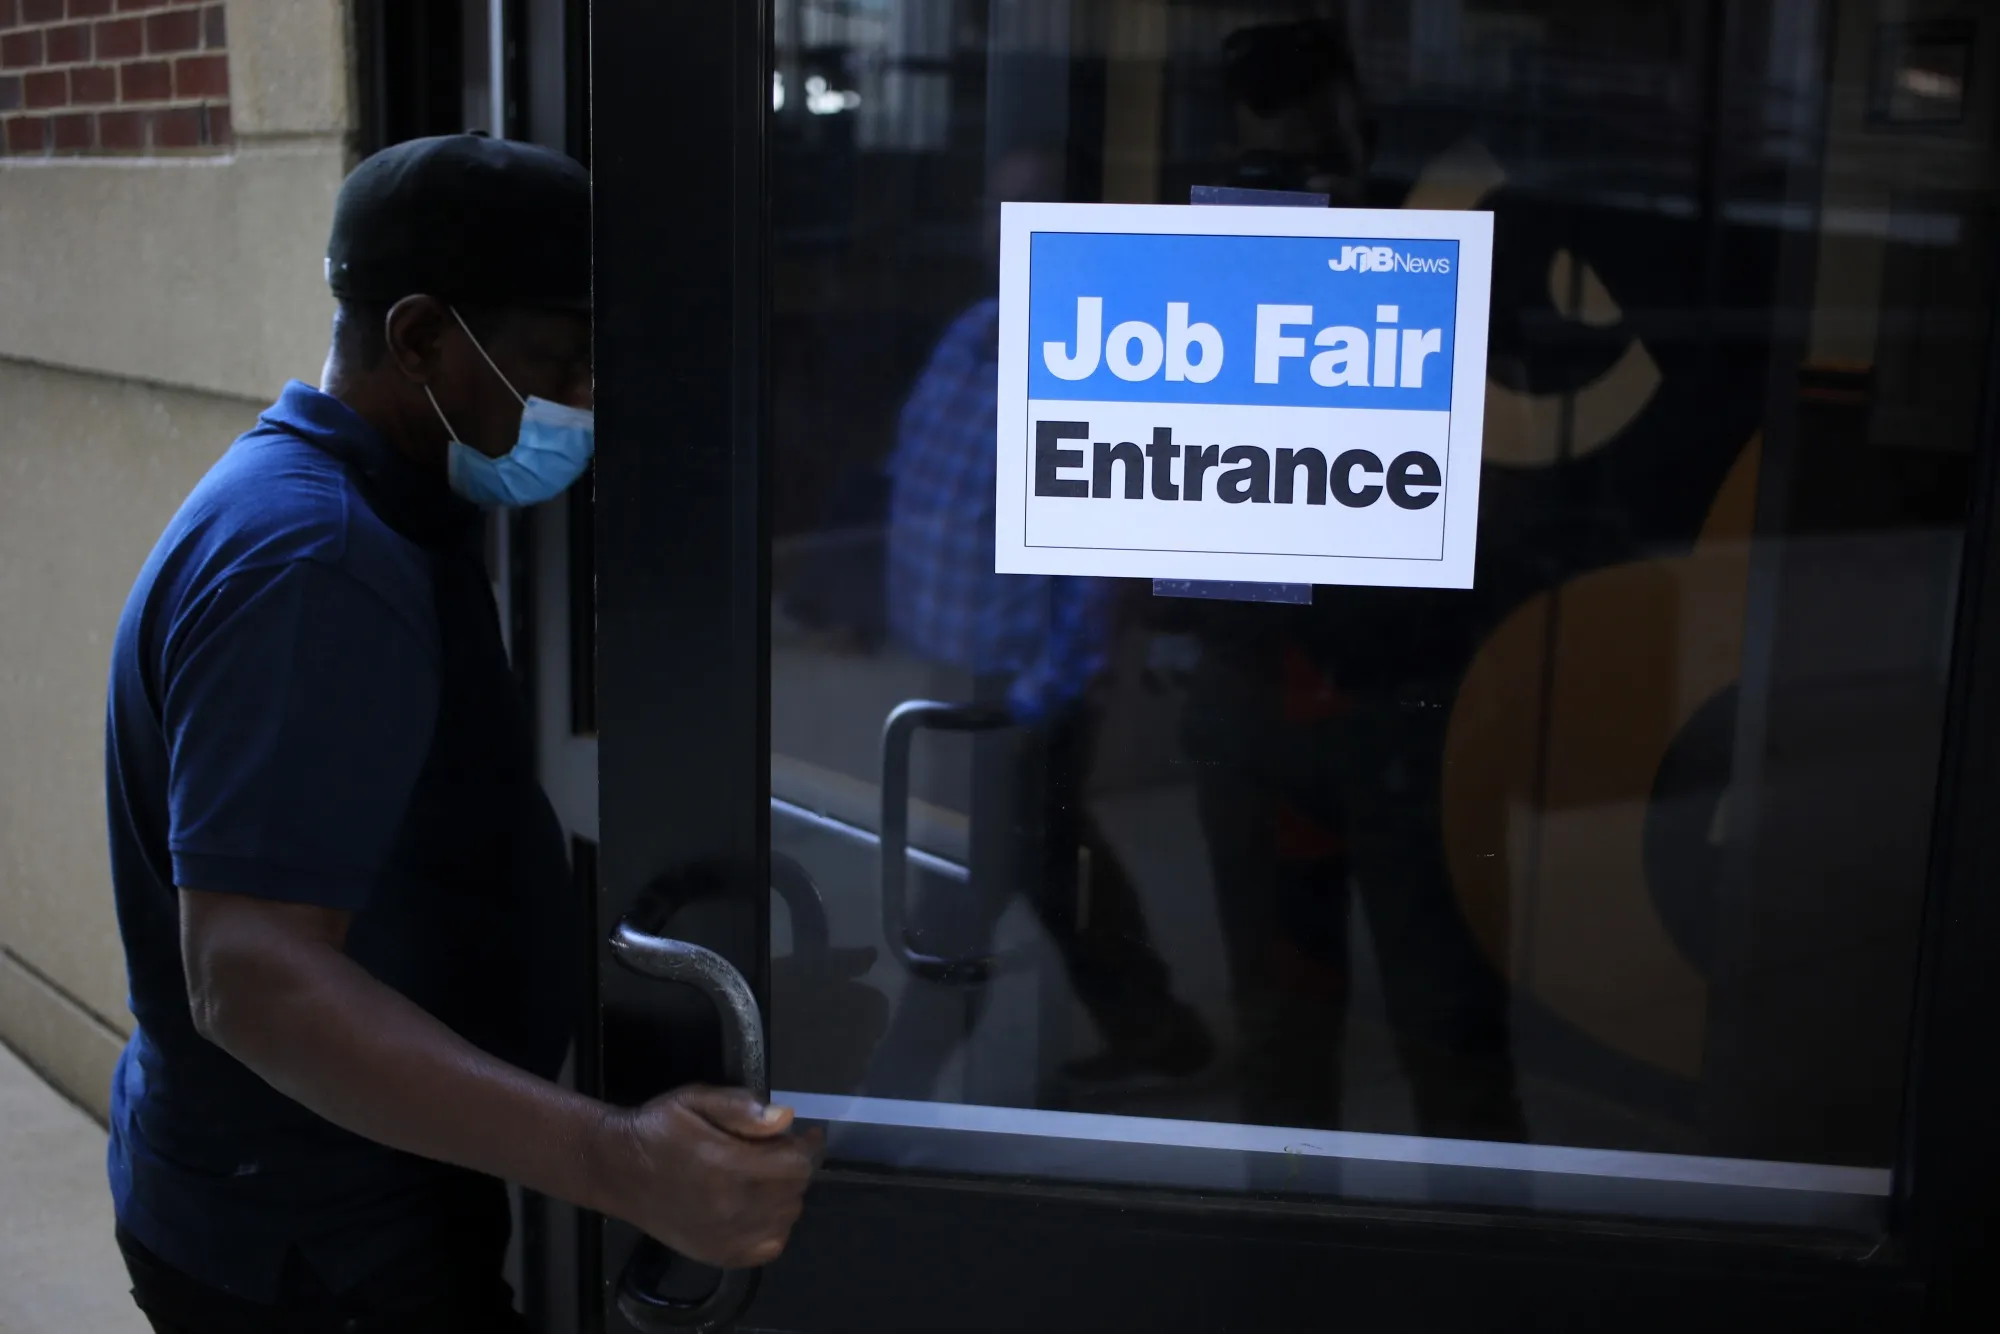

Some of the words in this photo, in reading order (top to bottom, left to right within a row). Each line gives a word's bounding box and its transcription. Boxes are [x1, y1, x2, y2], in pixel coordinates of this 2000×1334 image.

[1043, 296, 1224, 384] Job
[1254, 303, 1441, 388] Fair
[1034, 420, 1442, 510] Entrance
